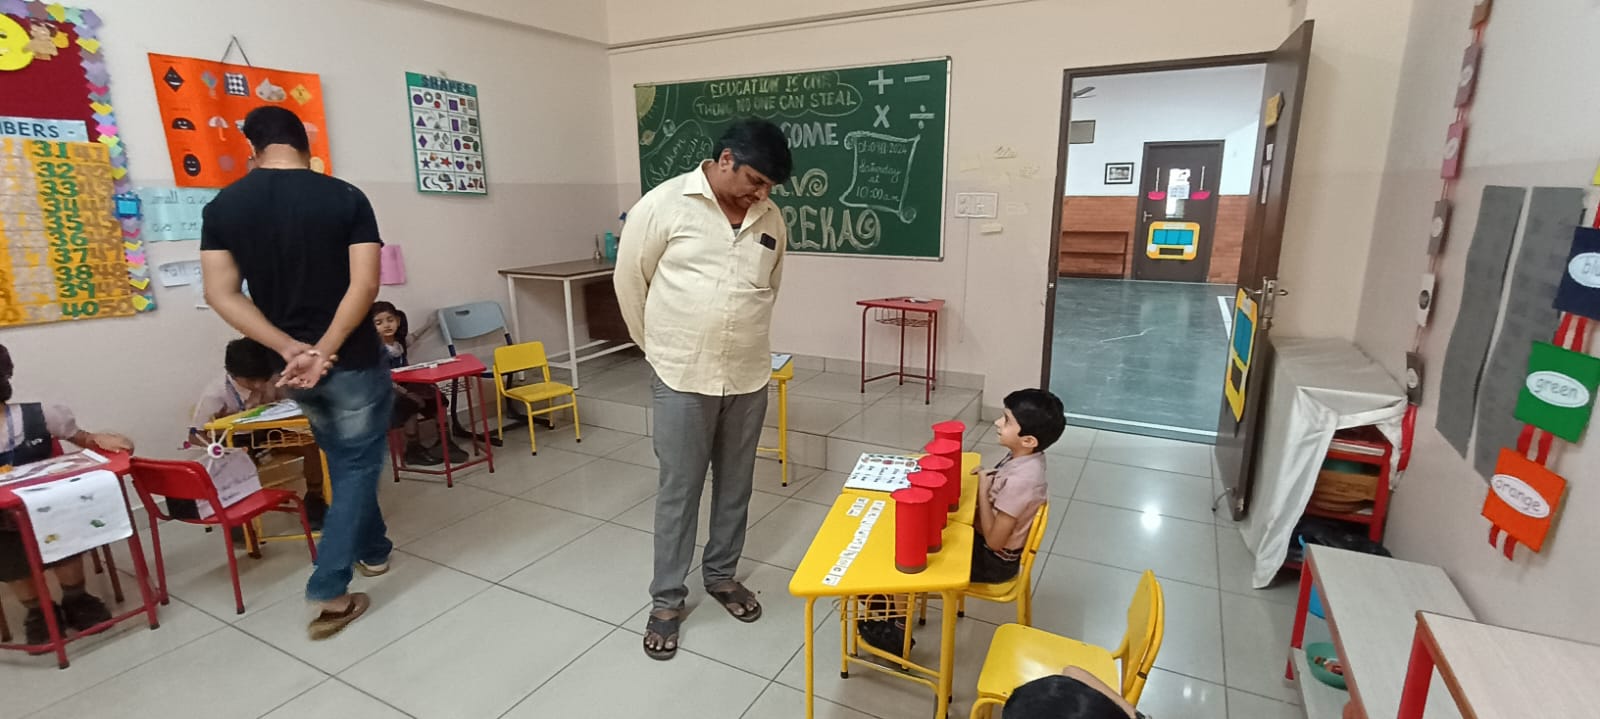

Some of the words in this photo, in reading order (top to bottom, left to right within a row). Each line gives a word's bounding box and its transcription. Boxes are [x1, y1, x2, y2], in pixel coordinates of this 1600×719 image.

[421, 74, 473, 96] SHAPES
[710, 77, 779, 99] EDUCATION
[785, 76, 798, 92] IS
[753, 95, 777, 111] ONE
[779, 93, 804, 111] CAN
[810, 90, 857, 108] STEAL
[0, 120, 60, 138] BERS
[780, 121, 839, 149] COME
[32, 140, 71, 159] 31
[36, 161, 76, 180] 32
[40, 180, 80, 198] 33
[43, 197, 80, 218] 34
[47, 213, 84, 232] 35
[782, 205, 881, 250] REKA
[50, 231, 89, 247] 36
[54, 247, 88, 264] 37
[56, 264, 94, 281] 38
[59, 280, 95, 299] 39
[62, 301, 100, 317] 40
[99, 298, 132, 315] 50
[1533, 377, 1579, 399] green
[1495, 479, 1542, 512] orange
